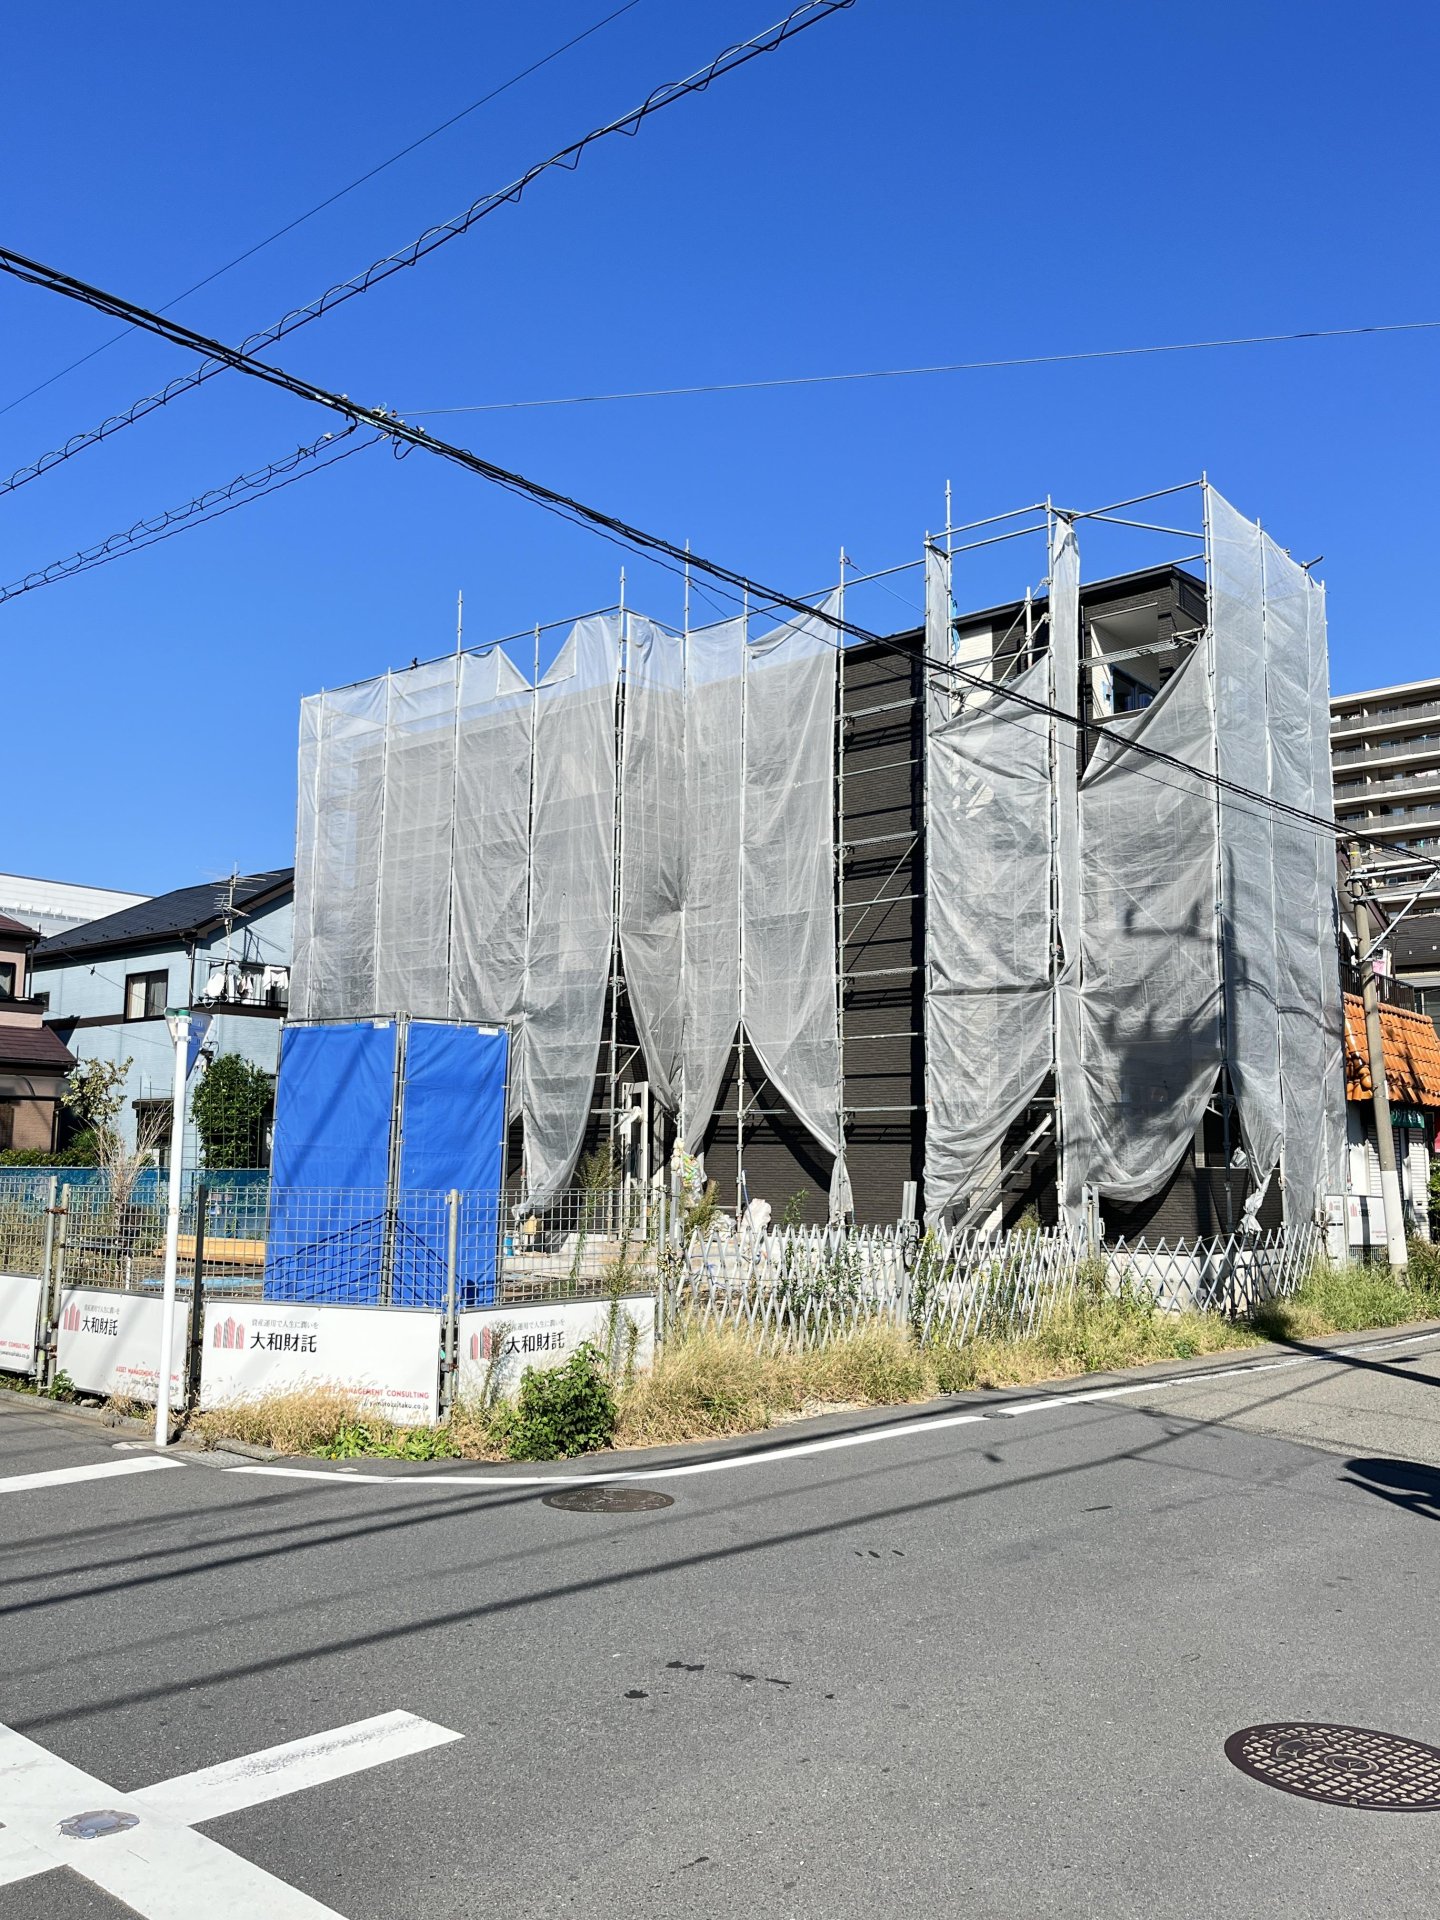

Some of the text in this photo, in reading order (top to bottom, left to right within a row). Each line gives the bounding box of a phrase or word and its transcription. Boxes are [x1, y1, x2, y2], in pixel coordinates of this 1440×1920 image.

[82, 1316, 118, 1336] 大和財託
[251, 1318, 319, 1330] 資産運用で人生に潤いを
[250, 1331, 317, 1353] 大和財託
[506, 1331, 565, 1355] 大和財託
[386, 1389, 430, 1399] CONSULTING
